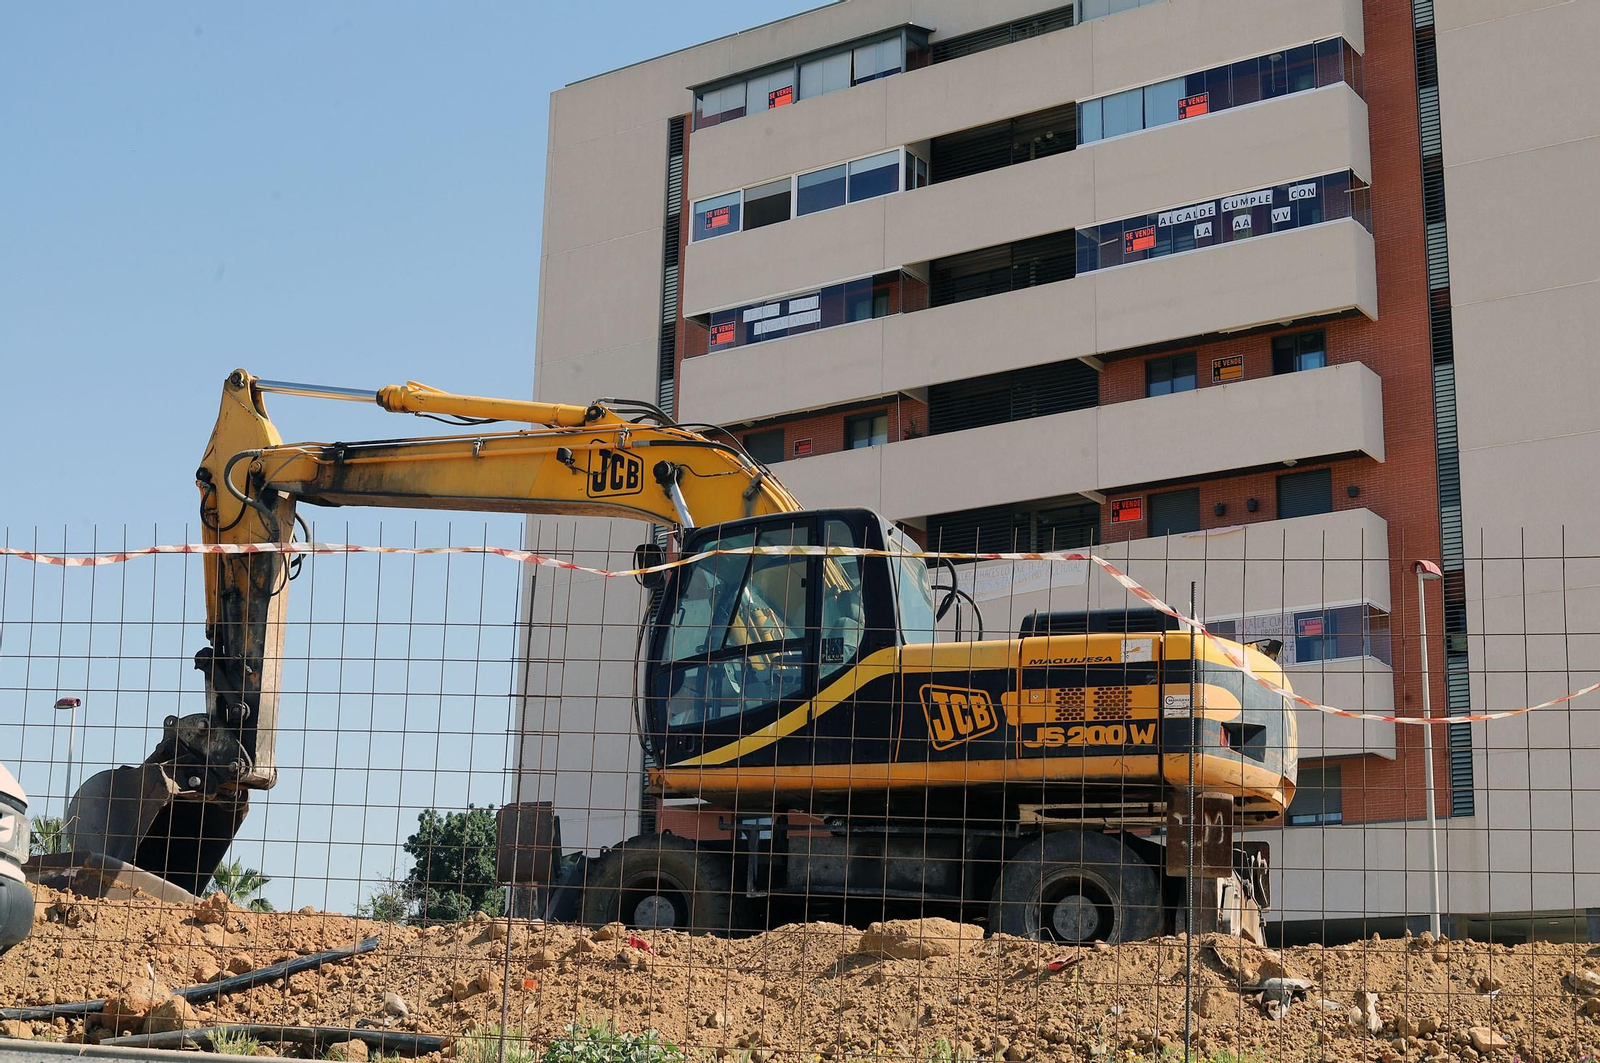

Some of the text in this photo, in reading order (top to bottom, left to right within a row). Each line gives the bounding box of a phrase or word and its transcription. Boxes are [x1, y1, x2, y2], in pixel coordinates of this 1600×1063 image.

[769, 86, 793, 100] SE VENDE
[1178, 94, 1208, 108] SE VENDE
[706, 206, 730, 219] SE VENDE
[1159, 186, 1316, 226] ALCALDE CUMPLE CON
[1195, 210, 1290, 237] LA AA VV
[1125, 227, 1155, 241] SE VENDE
[711, 323, 734, 334] SE VENDE
[1213, 356, 1242, 369] SE VENDE
[592, 448, 639, 492] JCB
[1112, 498, 1141, 510] SE VENDE
[1029, 656, 1113, 665] MAQUIJESA
[931, 691, 991, 741] JCB
